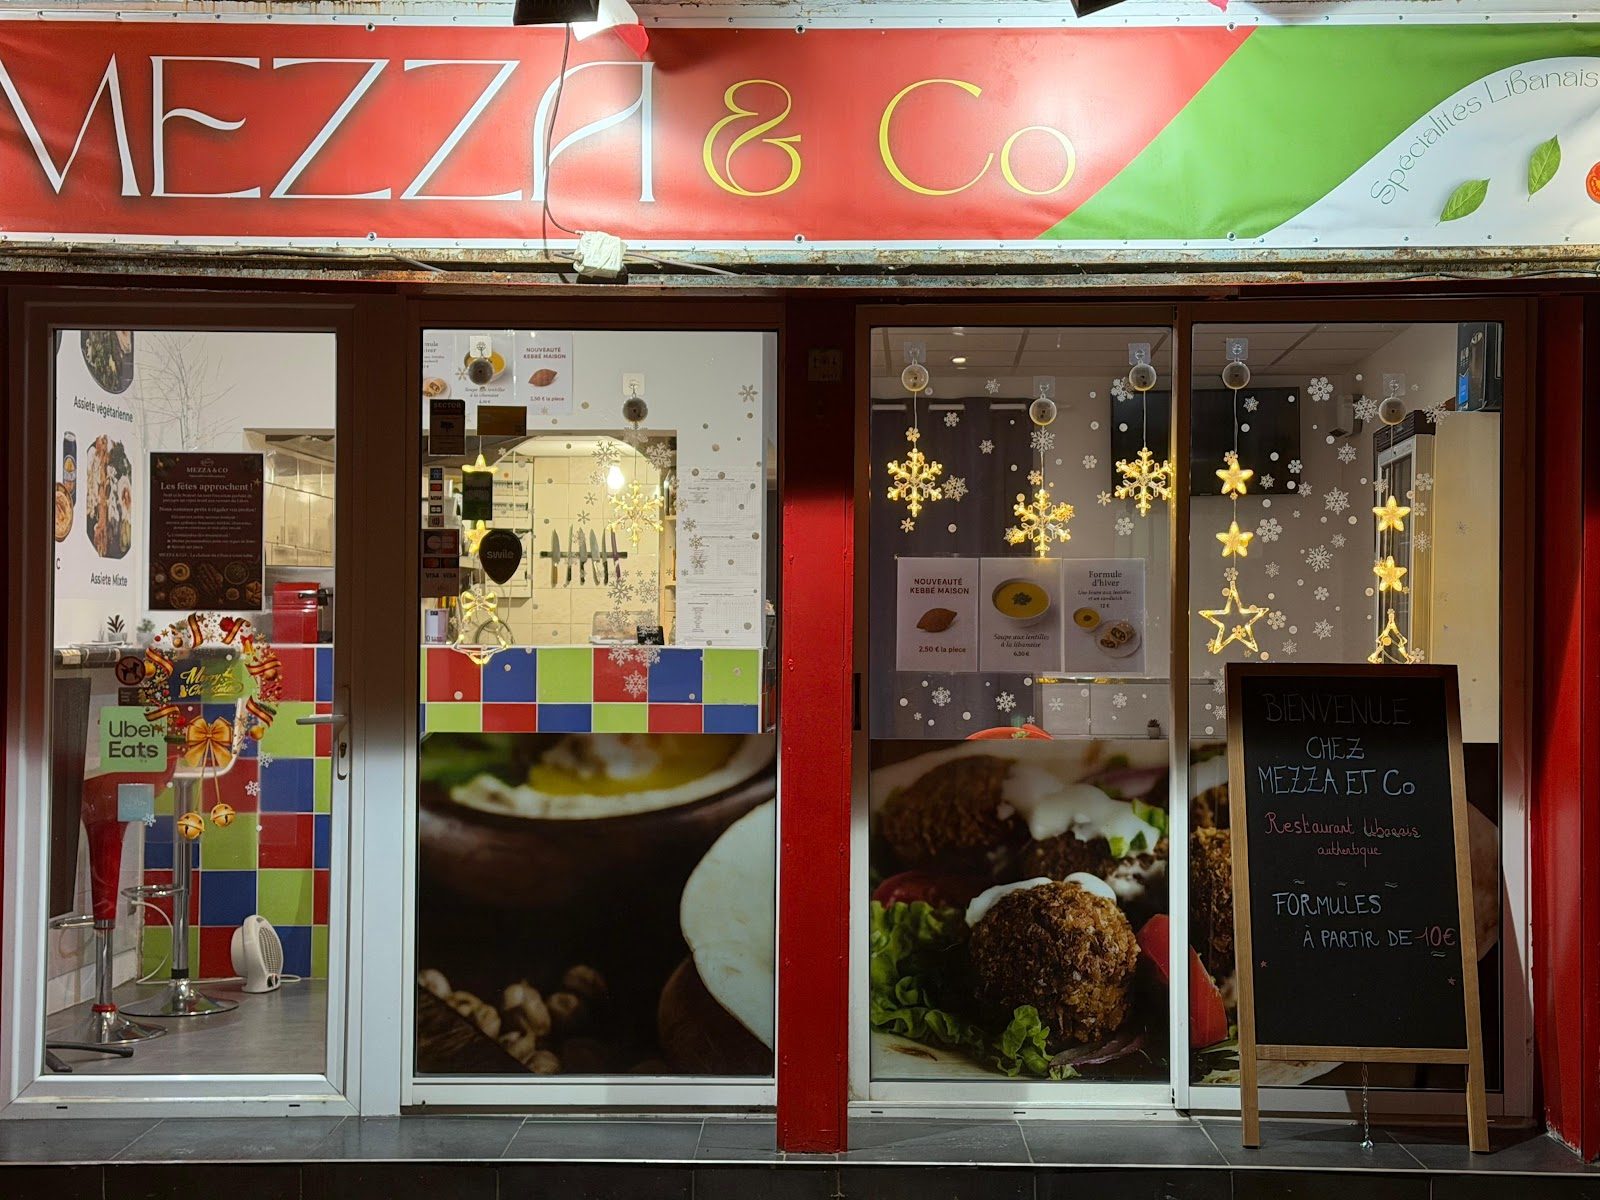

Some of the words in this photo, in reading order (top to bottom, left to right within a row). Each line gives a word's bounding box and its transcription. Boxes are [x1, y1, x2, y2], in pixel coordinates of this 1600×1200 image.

[0, 53, 655, 203] MEZZA
[703, 79, 801, 196] &
[879, 78, 1076, 196] Co
[1369, 96, 1482, 206] Spécialités
[1484, 69, 1599, 104] Libanais
[73, 395, 96, 413] Assiete
[160, 482, 176, 490] Les
[177, 482, 197, 490] fêtes
[199, 482, 248, 492] approchent
[914, 578, 963, 586] NOUVEAUTÉ
[1089, 570, 1123, 578] Formule
[1261, 693, 1412, 726] BIENVENUE
[109, 721, 158, 738] Uber
[109, 741, 159, 759] Eats
[1306, 736, 1365, 761] CHEZ
[1258, 765, 1338, 795] MEZZA
[1346, 769, 1377, 796] ET
[1382, 769, 1416, 796] Co
[1264, 811, 1355, 835] Restaurant
[1317, 841, 1383, 868] authentique
[1272, 892, 1382, 917] FORMULES
[1303, 925, 1315, 948] À
[1388, 929, 1413, 947] DE
